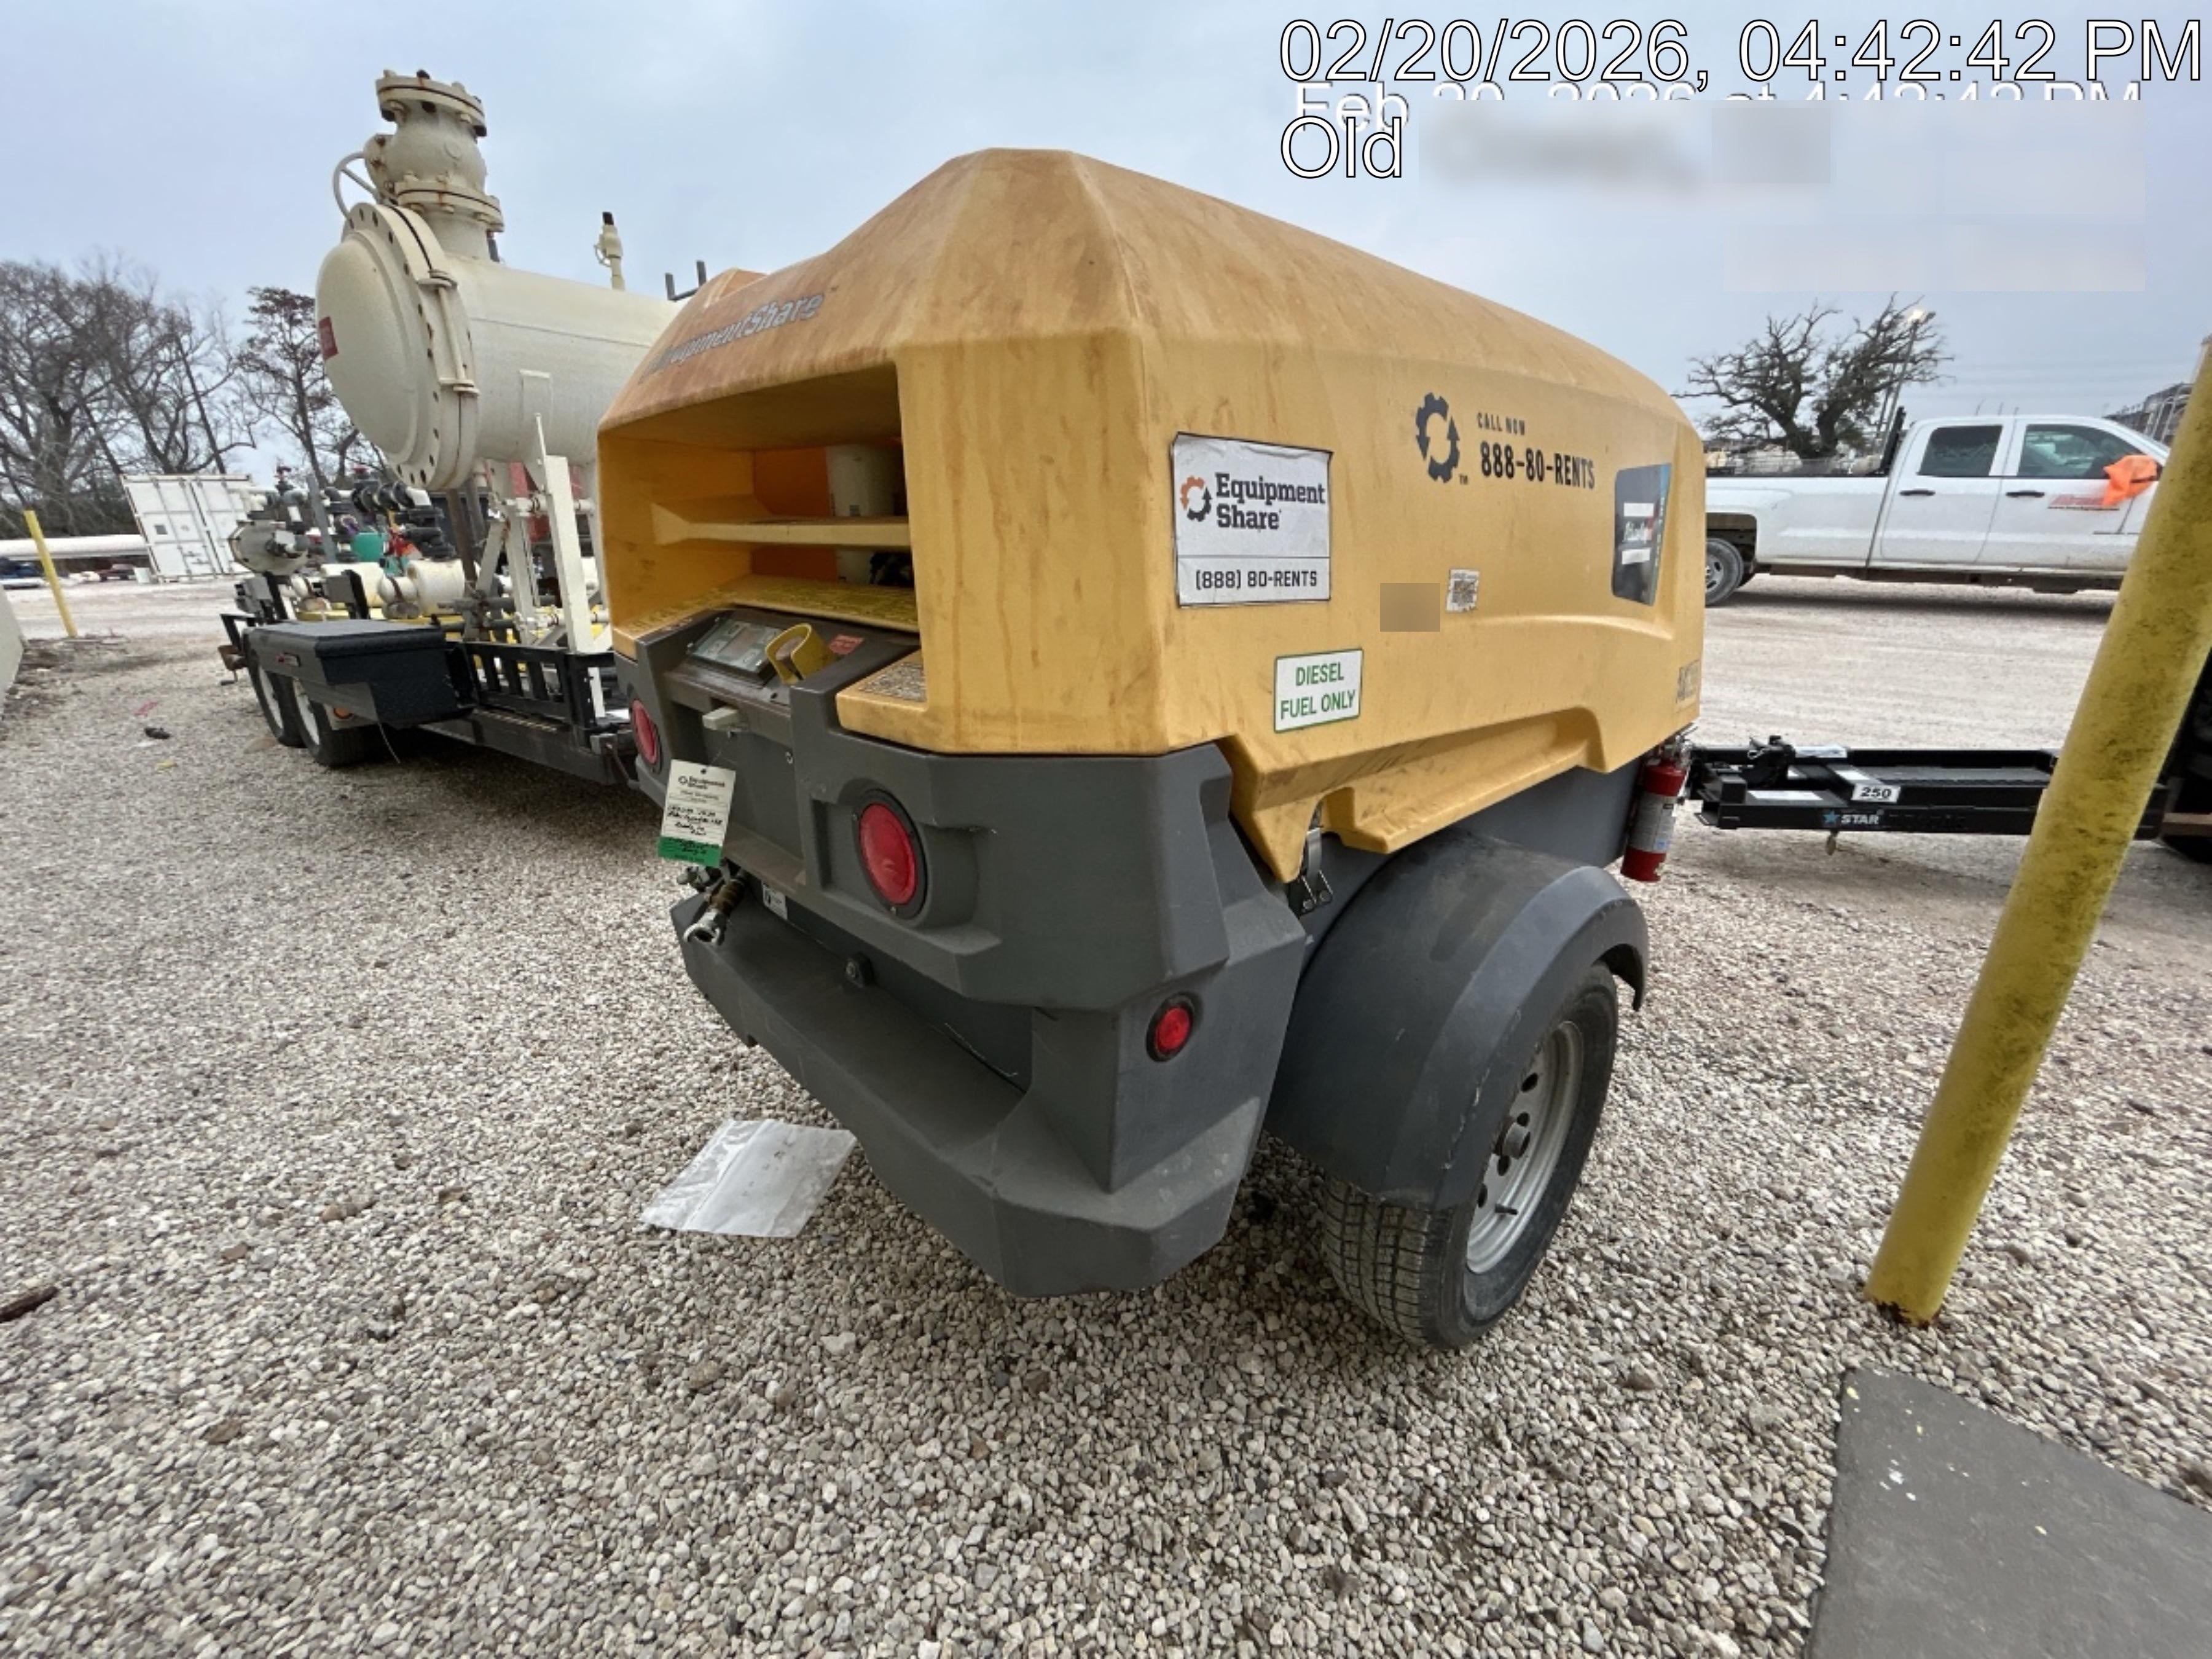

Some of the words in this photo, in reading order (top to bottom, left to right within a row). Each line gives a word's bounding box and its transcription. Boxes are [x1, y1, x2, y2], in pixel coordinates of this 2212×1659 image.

[642, 292, 825, 375] pmentShare
[1477, 412, 1503, 432] CALL
[1480, 441, 1594, 489] 888-80-RENTS
[1215, 472, 1325, 505] Equipment
[1217, 503, 1279, 530] Share
[1196, 570, 1241, 590] (888)
[1247, 570, 1317, 587] 80-RENTS
[1295, 662, 1344, 686] DIESEL
[1281, 696, 1317, 720] FUEL
[1321, 689, 1355, 712] ONLY
[1861, 786, 1892, 799] 250
[1841, 814, 1879, 825] STAR
